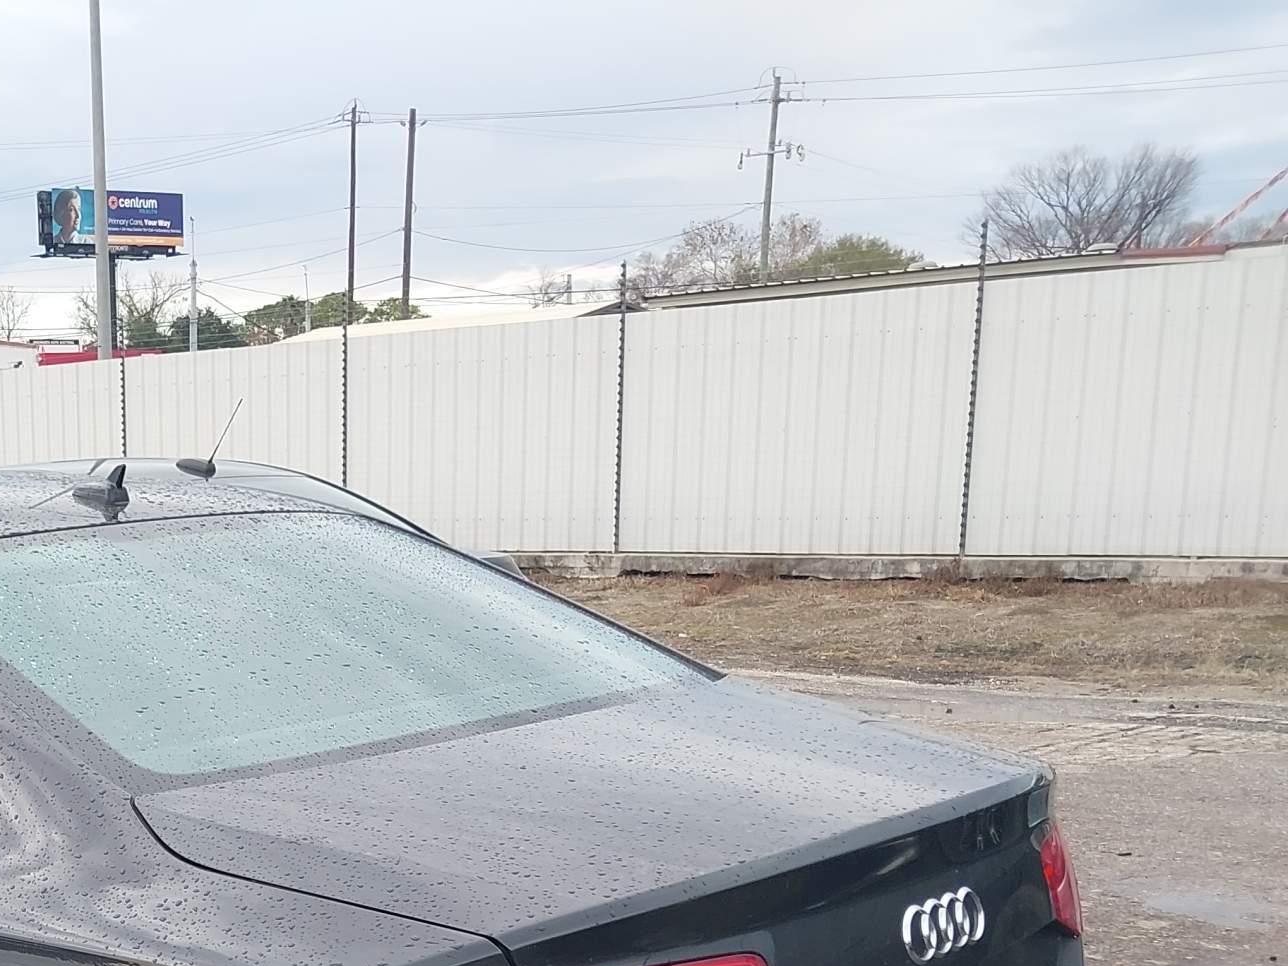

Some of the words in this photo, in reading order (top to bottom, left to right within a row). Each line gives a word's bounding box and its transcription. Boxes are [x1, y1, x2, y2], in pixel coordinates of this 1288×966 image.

[118, 196, 158, 209] centrum
[108, 218, 129, 227] Primary
[158, 219, 171, 228] Way
